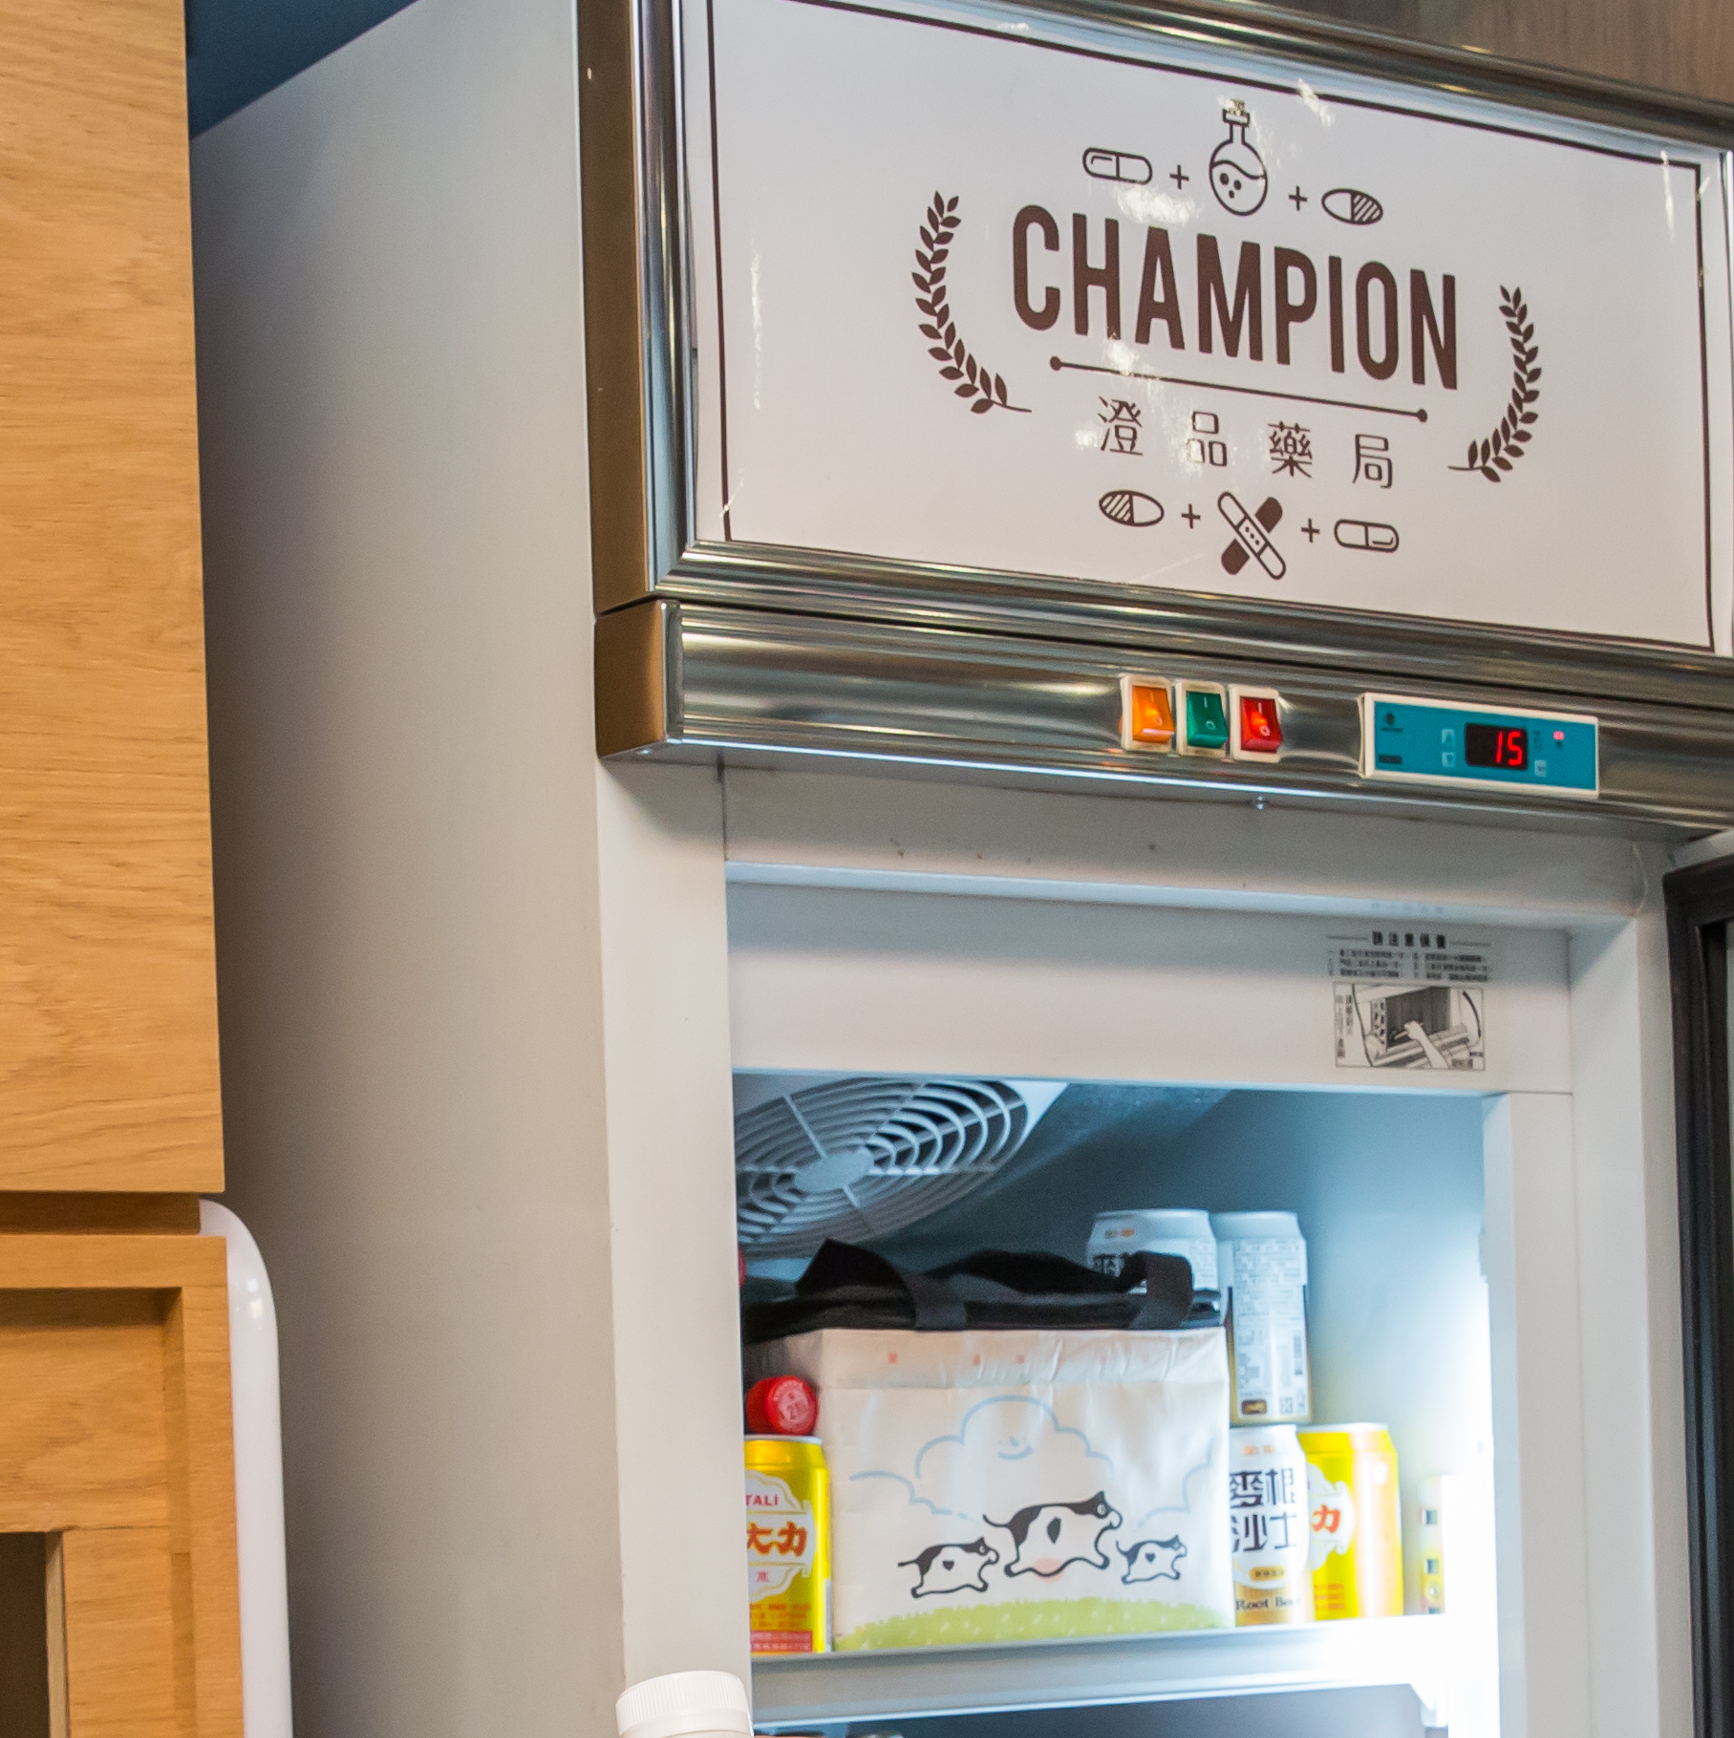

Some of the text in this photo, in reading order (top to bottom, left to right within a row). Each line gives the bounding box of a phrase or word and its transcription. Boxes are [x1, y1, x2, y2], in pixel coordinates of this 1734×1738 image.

[1012, 203, 1458, 390] CHAMPION
[1098, 397, 1395, 490] 澄品藥局
[1496, 730, 1523, 766] 15
